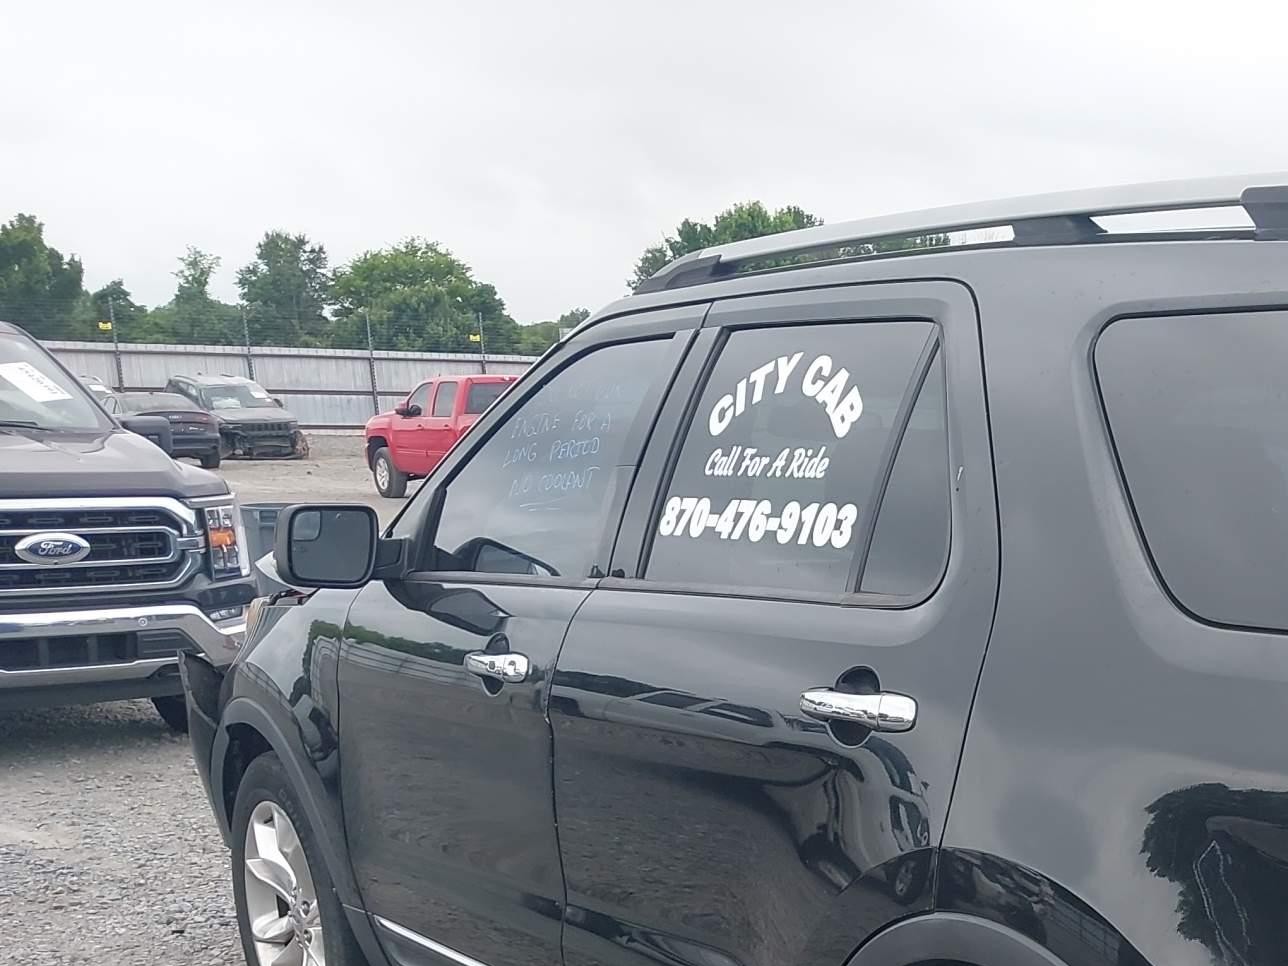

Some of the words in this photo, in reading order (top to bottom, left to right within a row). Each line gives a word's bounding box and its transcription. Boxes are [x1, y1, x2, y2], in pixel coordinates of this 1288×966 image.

[708, 351, 804, 436] CITY
[802, 354, 863, 438] CAB
[572, 410, 594, 432] FOR
[502, 442, 538, 469] LONG
[549, 436, 600, 463] PERIOD
[705, 446, 742, 477] Call
[737, 447, 770, 478] For
[767, 448, 789, 478] A
[785, 446, 830, 480] Ride
[540, 465, 601, 492] COOLANT
[658, 496, 858, 549] 870-476-9103
[38, 541, 72, 555] Ford
